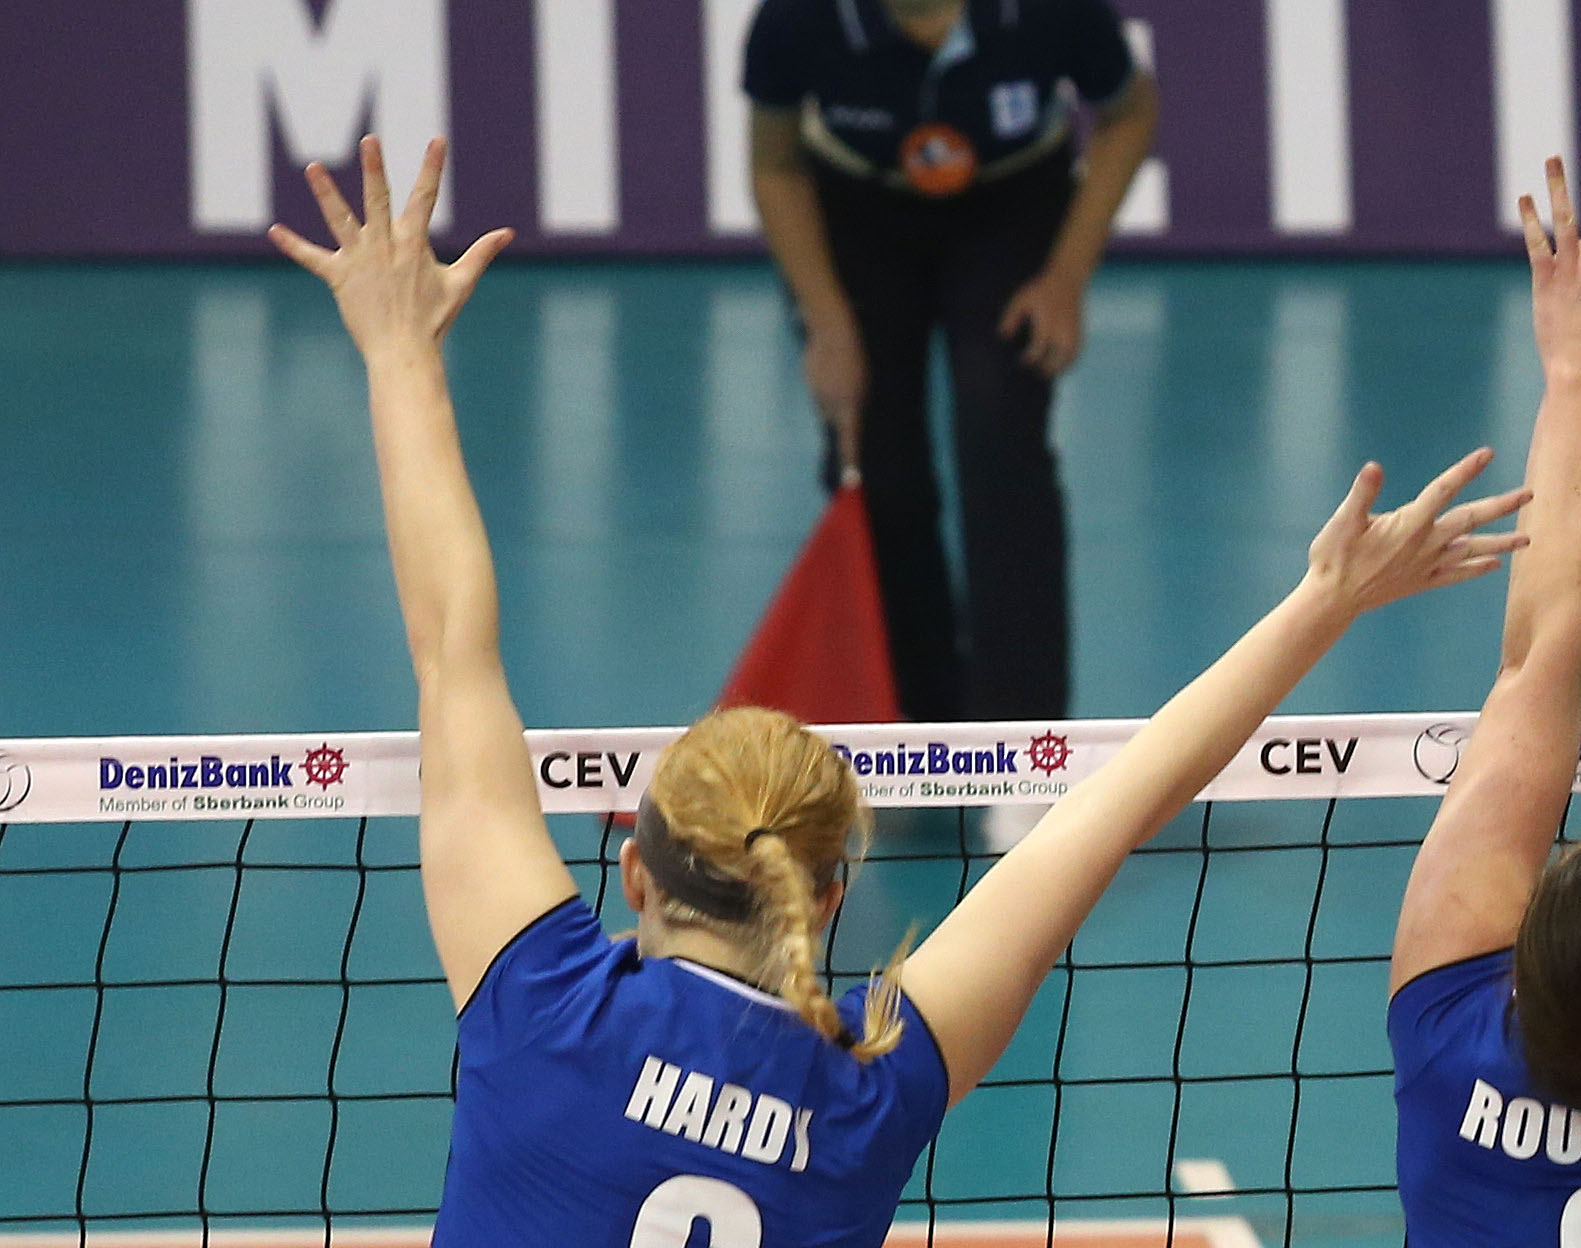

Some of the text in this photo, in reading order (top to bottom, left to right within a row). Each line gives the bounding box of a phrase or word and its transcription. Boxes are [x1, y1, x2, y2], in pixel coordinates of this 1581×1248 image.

[100, 755, 293, 789] DenizBank
[540, 750, 641, 788] CEV
[1259, 737, 1359, 775] CEV
[99, 793, 345, 812] Member of Sberbank Group
[900, 781, 916, 797] of
[920, 780, 1014, 797] Sberbank
[1018, 779, 1068, 797] Group
